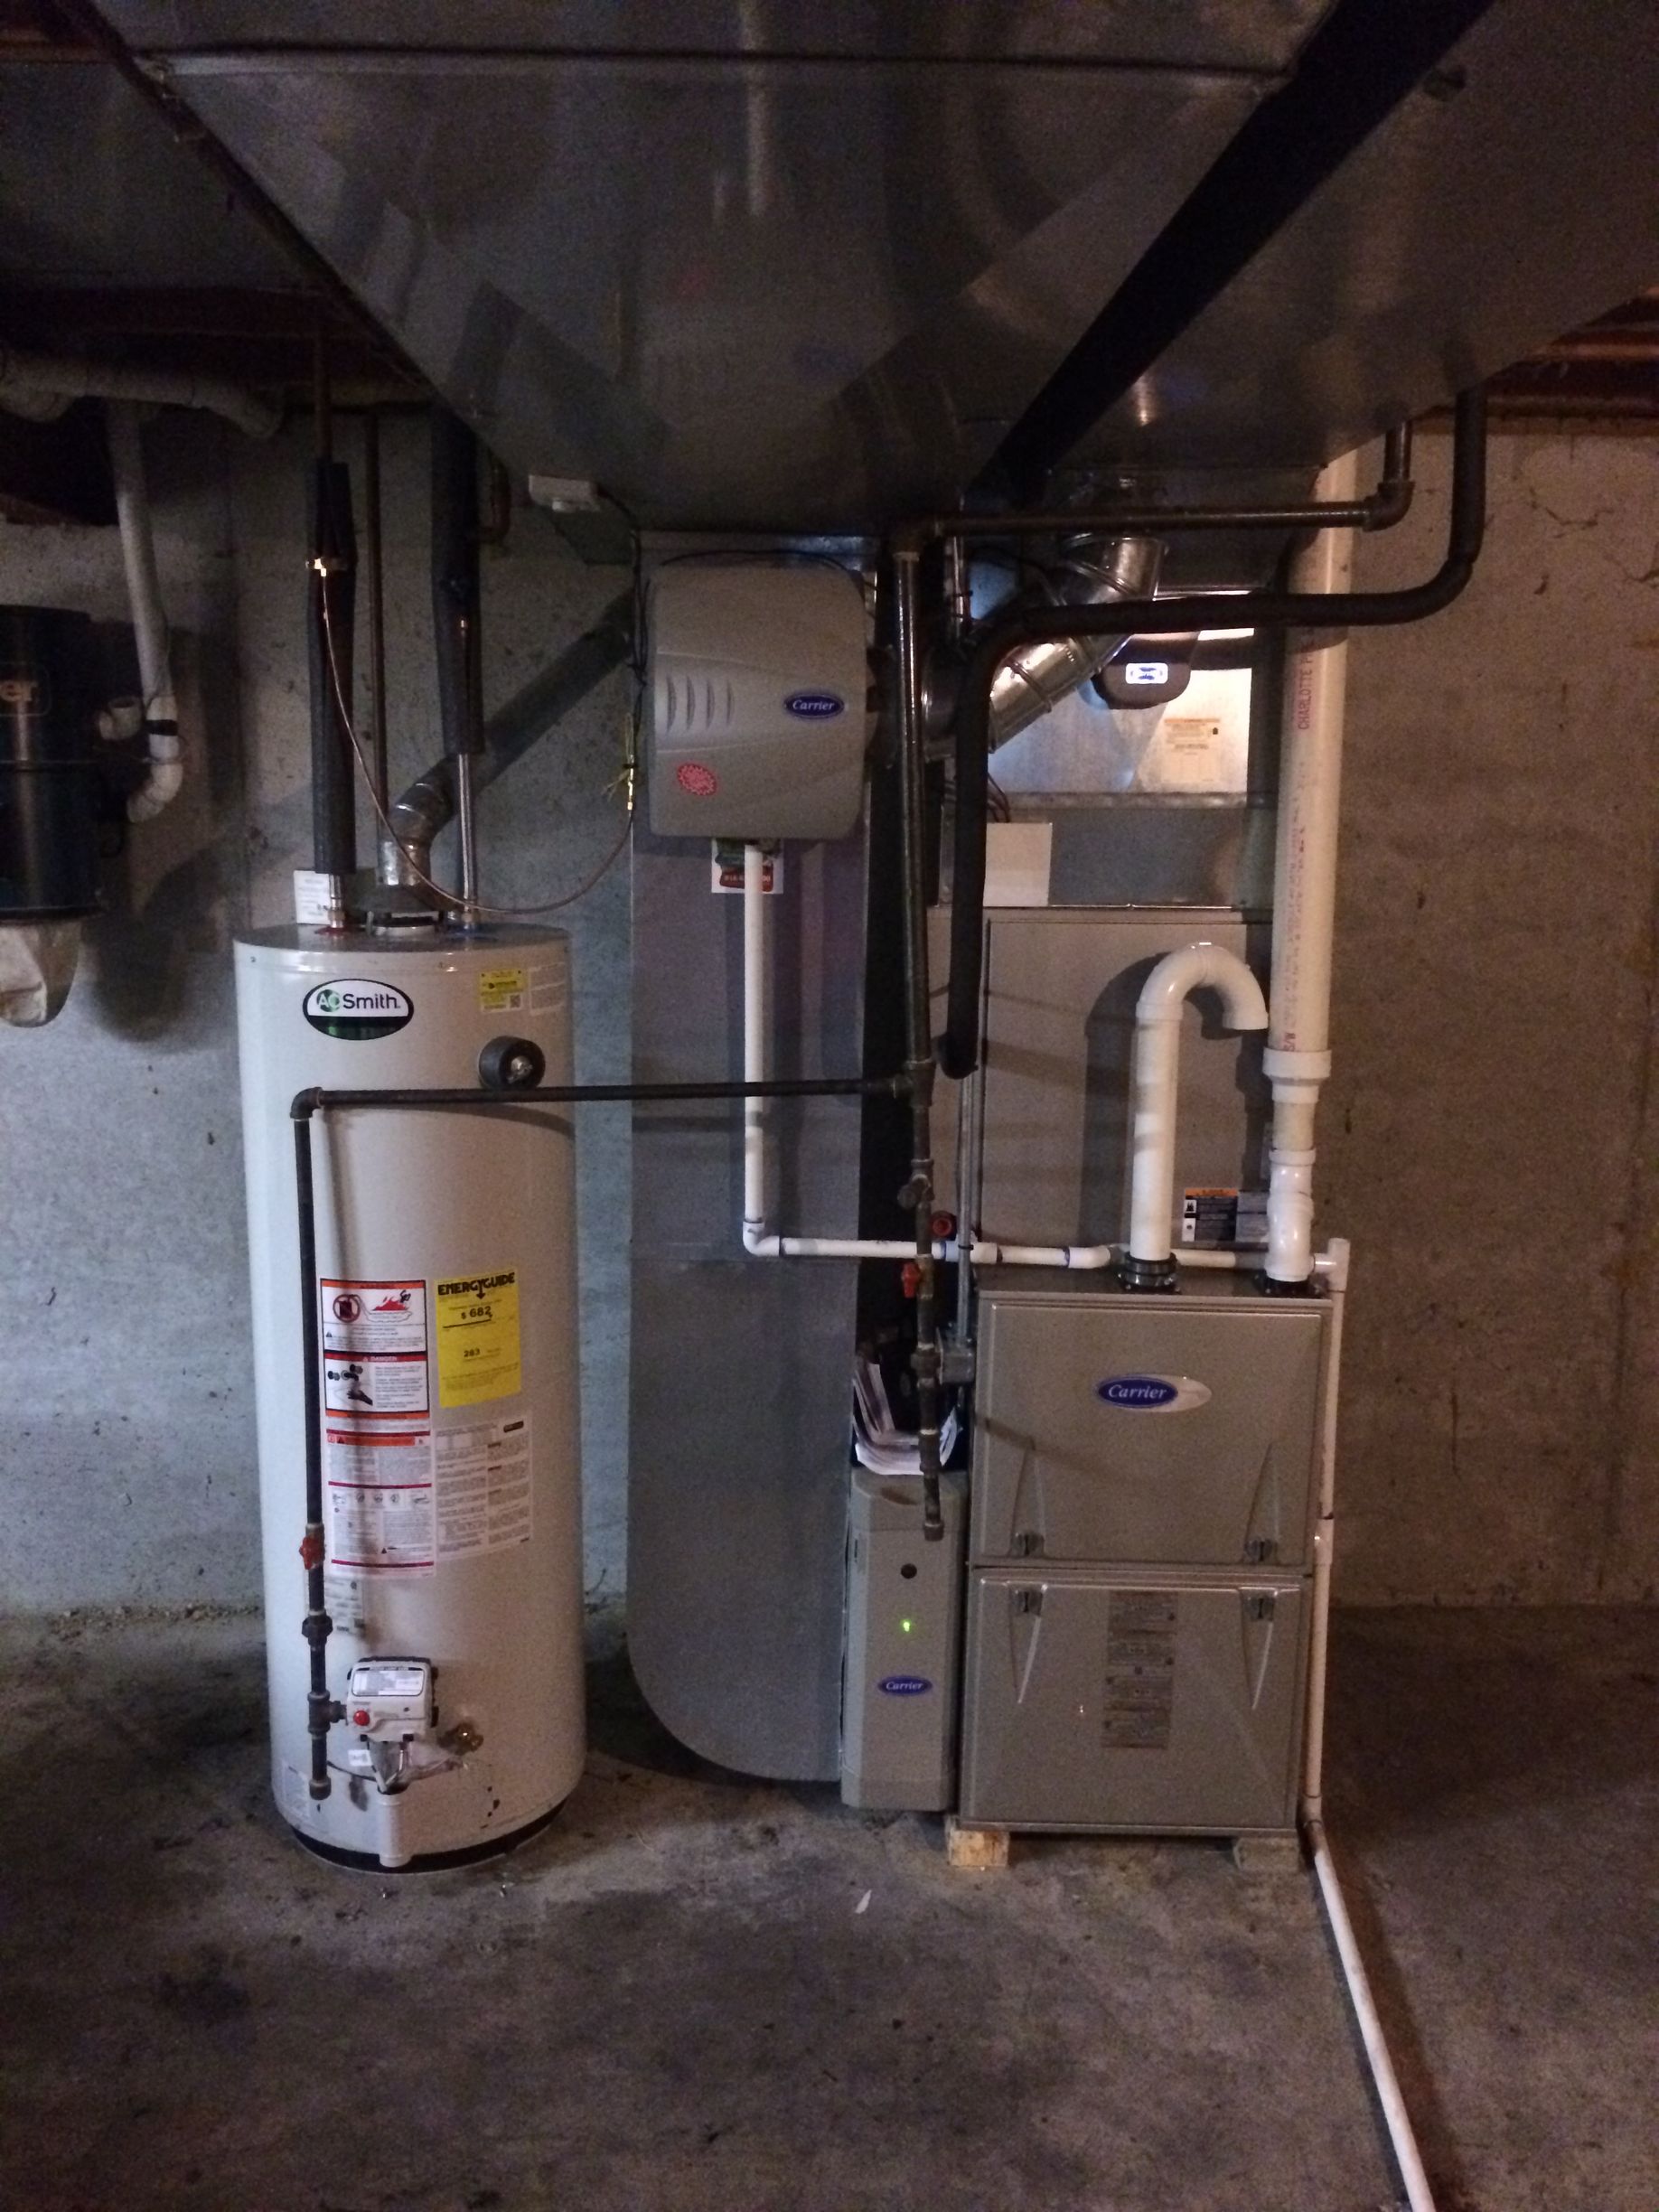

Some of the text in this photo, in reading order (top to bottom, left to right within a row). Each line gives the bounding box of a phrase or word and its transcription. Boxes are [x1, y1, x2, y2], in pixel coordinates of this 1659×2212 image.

[792, 698, 835, 711] Carrier
[1298, 669, 1313, 729] CHARLOTTE
[342, 992, 398, 1010] Smith
[438, 1272, 514, 1297] ENERGYGUIDE
[470, 1306, 491, 1317] 682
[1108, 1383, 1167, 1400] Carrier
[886, 1680, 924, 1691] Carrier
